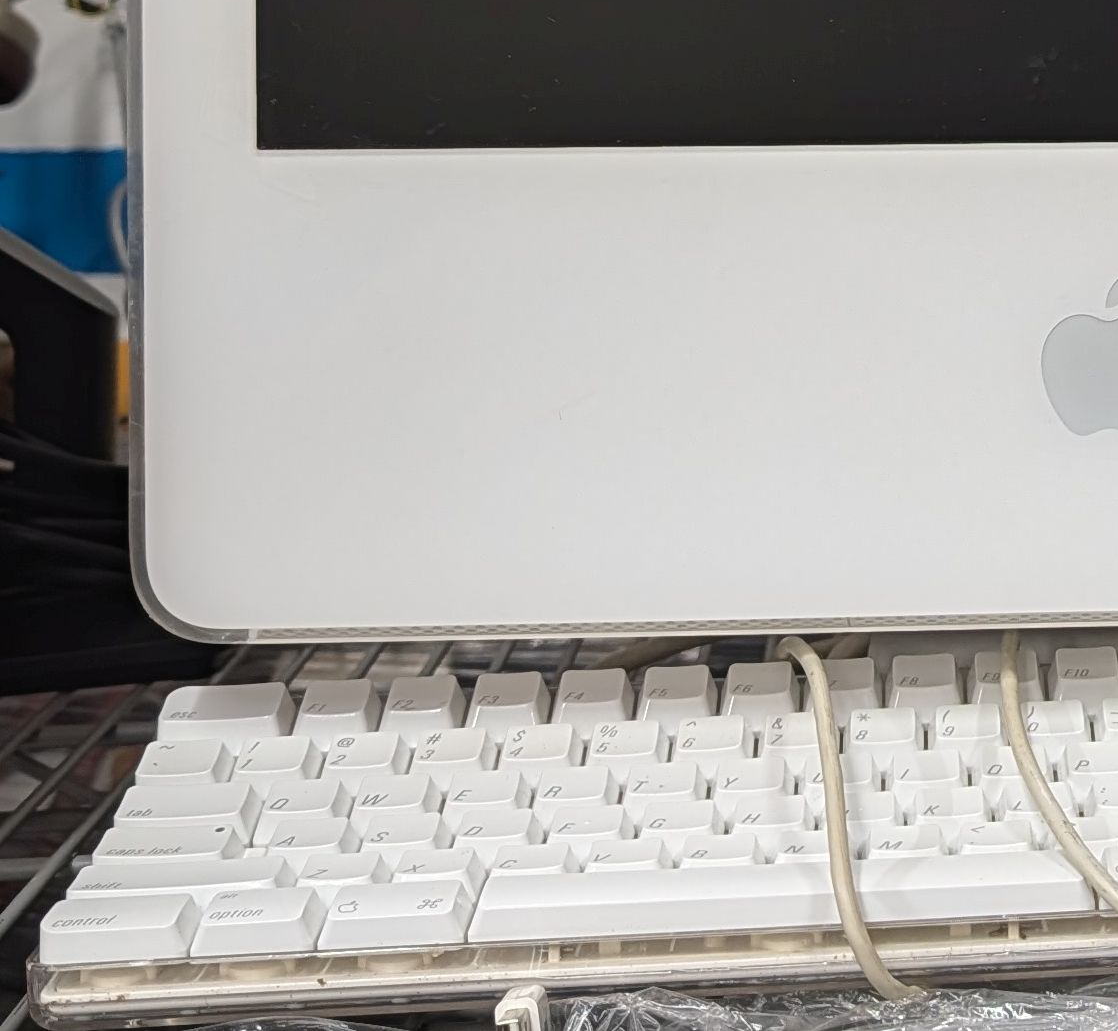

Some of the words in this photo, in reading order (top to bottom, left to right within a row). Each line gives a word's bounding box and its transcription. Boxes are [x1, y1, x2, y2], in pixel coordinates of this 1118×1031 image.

[1064, 669, 1090, 677] F10
[900, 676, 919, 686] F8
[650, 688, 668, 697] F5
[733, 684, 753, 693] F6
[478, 695, 500, 704] F3
[564, 692, 585, 700] F4
[306, 703, 327, 713] F1
[392, 699, 414, 710] F2
[170, 711, 197, 719] esc
[772, 718, 783, 730] &
[1027, 721, 1039, 732] 0
[600, 725, 618, 738] %
[856, 730, 868, 740] 8
[942, 726, 955, 737] 9
[337, 737, 356, 748] @
[426, 732, 442, 745] #
[682, 737, 697, 748] 6
[771, 734, 783, 745] 7
[510, 747, 524, 757] 4
[596, 742, 611, 753] 5
[330, 754, 346, 765] 2
[420, 749, 435, 760] 3
[987, 764, 1003, 775] O
[1075, 759, 1090, 770] P
[633, 780, 649, 792] T
[723, 777, 739, 788] Y
[454, 789, 472, 801] E
[543, 785, 563, 797] R
[361, 793, 390, 805] W
[923, 804, 940, 815] K
[1012, 801, 1023, 811] L
[126, 809, 153, 817] tab
[742, 813, 761, 824] H
[557, 822, 576, 833] F
[649, 818, 666, 828] G
[370, 831, 390, 842] S
[464, 826, 484, 836] D
[276, 836, 296, 846] A
[878, 841, 904, 850] M
[105, 848, 144, 856] caps
[149, 845, 182, 855] lock
[690, 849, 708, 859] B
[784, 845, 805, 853] N
[499, 859, 518, 868] C
[594, 854, 612, 862] V
[307, 869, 329, 878] Z
[403, 864, 426, 873] X
[208, 908, 264, 921] option
[51, 915, 118, 928] control
